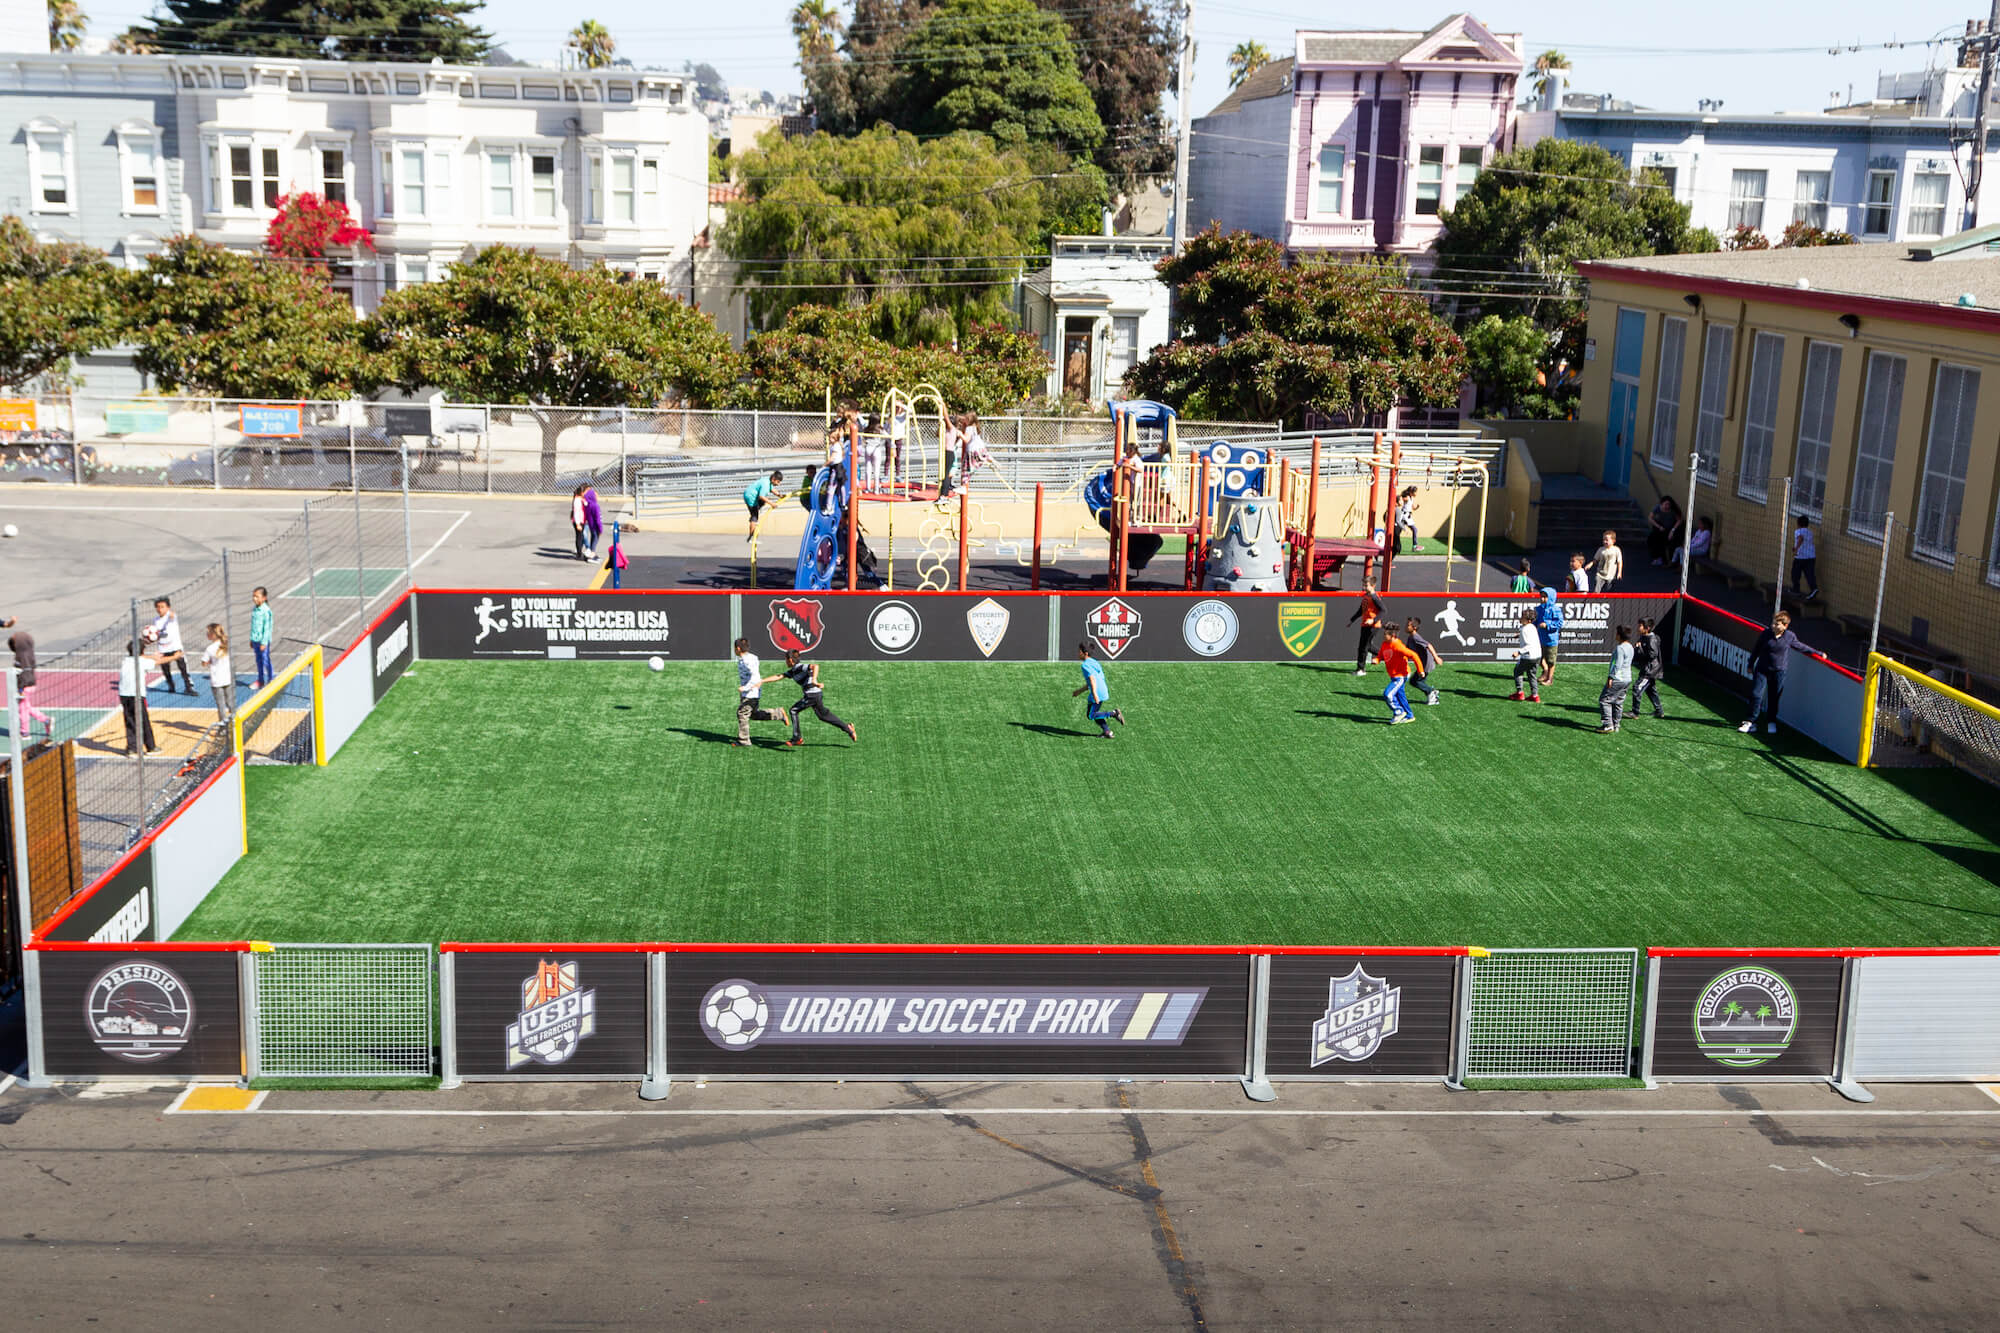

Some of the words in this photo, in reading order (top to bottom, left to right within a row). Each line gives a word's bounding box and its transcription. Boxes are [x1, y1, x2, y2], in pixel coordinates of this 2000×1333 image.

[511, 598, 526, 610] DO
[527, 598, 548, 610] YOU
[549, 598, 577, 610] WANT
[1196, 604, 1217, 615] PRIDE
[1481, 602, 1508, 619] THE
[1565, 603, 1610, 619] STARS
[512, 610, 572, 628] STREET
[574, 611, 635, 628] SOCCER
[638, 611, 669, 628] USA
[778, 607, 812, 645] FAMILY
[1480, 619, 1503, 629] COULD
[547, 629, 558, 641] IN
[559, 629, 586, 641] YOUR
[587, 629, 669, 641] NEIGHBORHOOD?
[1098, 624, 1131, 637] CHANGE
[101, 967, 177, 992] PRESIDIO
[1701, 975, 1738, 1016] GOLDEN
[1740, 973, 1773, 987] GATE
[1770, 982, 1793, 1016] PARK
[524, 997, 577, 1032] USP
[779, 997, 897, 1033] URBAN
[897, 998, 1026, 1033] SOCCER
[1027, 999, 1123, 1034] PARK
[1333, 997, 1382, 1028] USP
[524, 1034, 539, 1047] SAN
[539, 1017, 577, 1042] FRANCISCO
[1347, 1021, 1367, 1036] SOCCER
